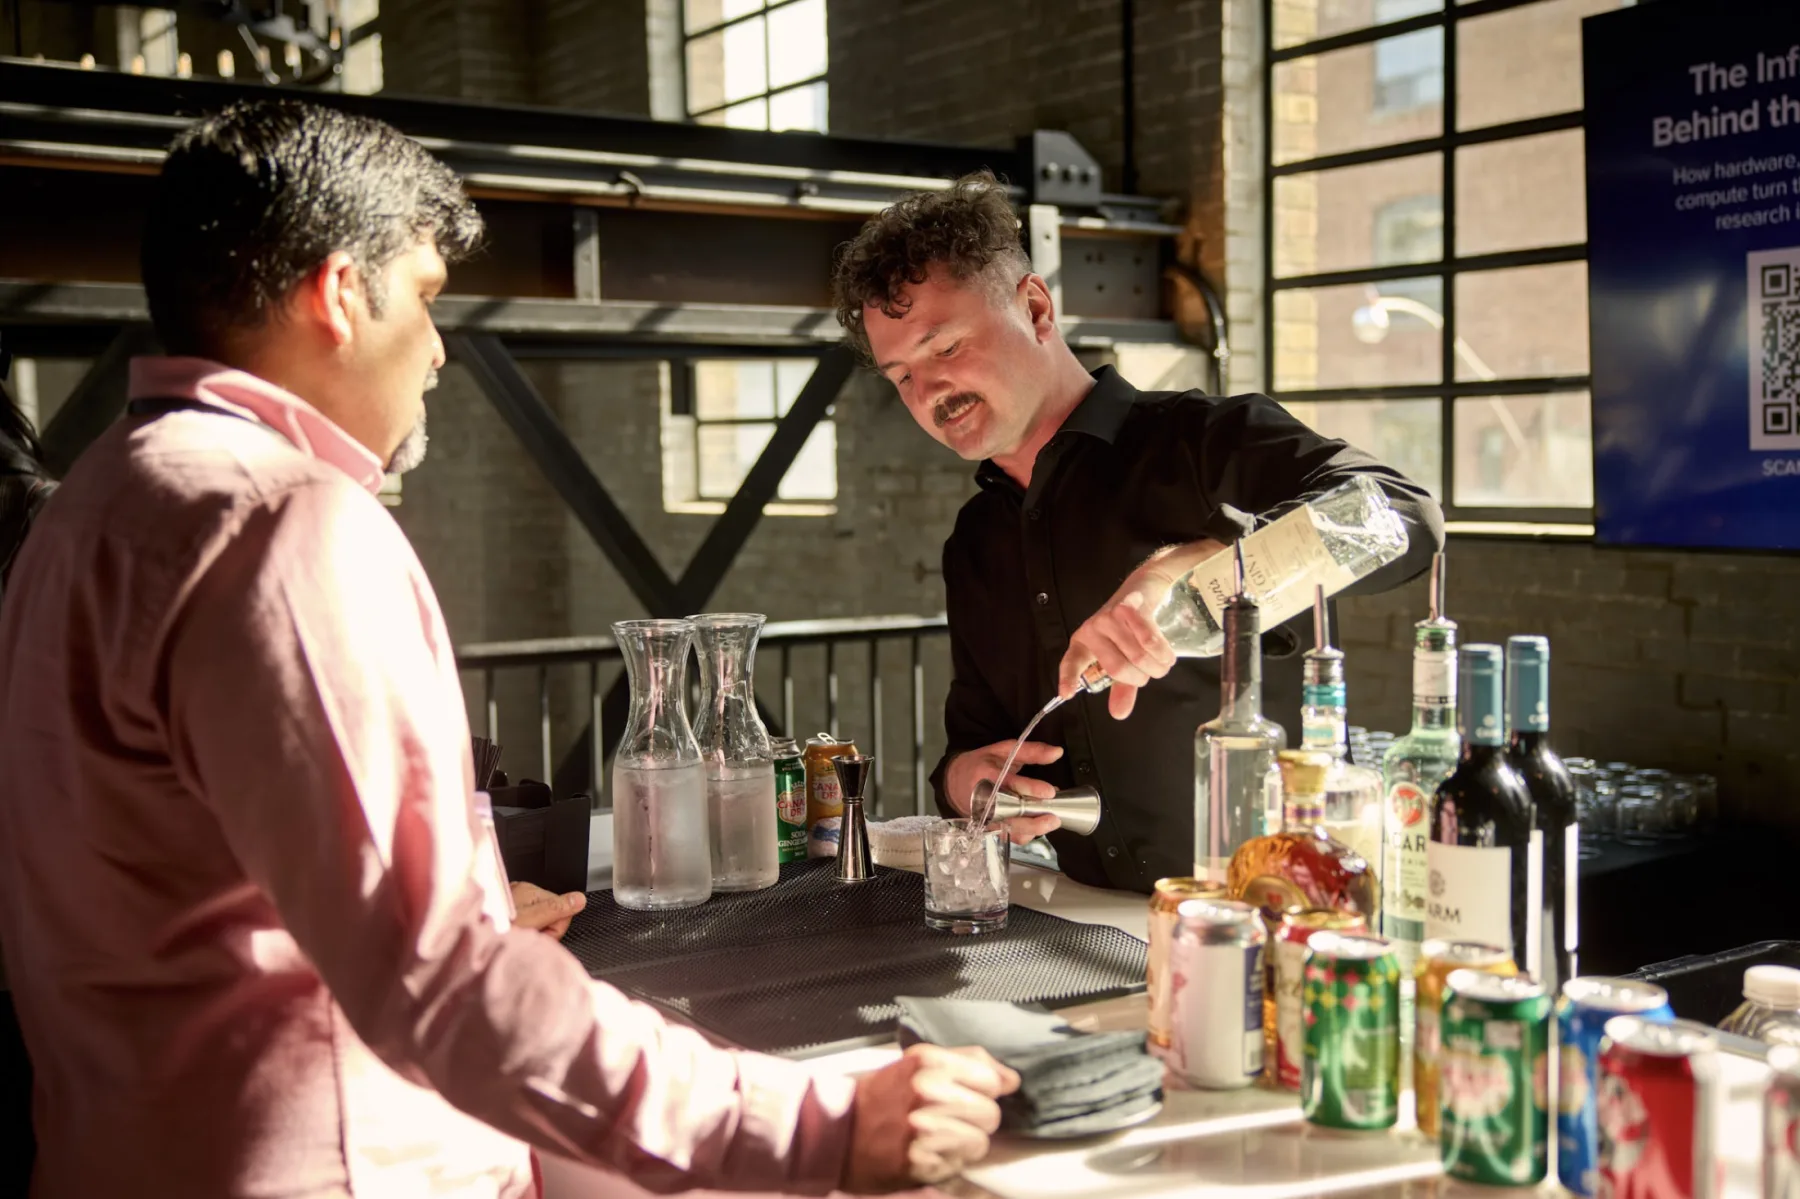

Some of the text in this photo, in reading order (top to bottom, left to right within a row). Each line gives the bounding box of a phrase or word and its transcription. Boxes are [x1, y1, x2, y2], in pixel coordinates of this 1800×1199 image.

[1689, 45, 1800, 95] The Inf
[1652, 99, 1760, 147] Behind
[1672, 165, 1711, 185] How
[1675, 186, 1749, 211] compute
[1752, 180, 1788, 200] turn
[1715, 203, 1790, 230] research
[1246, 560, 1266, 587] GIN
